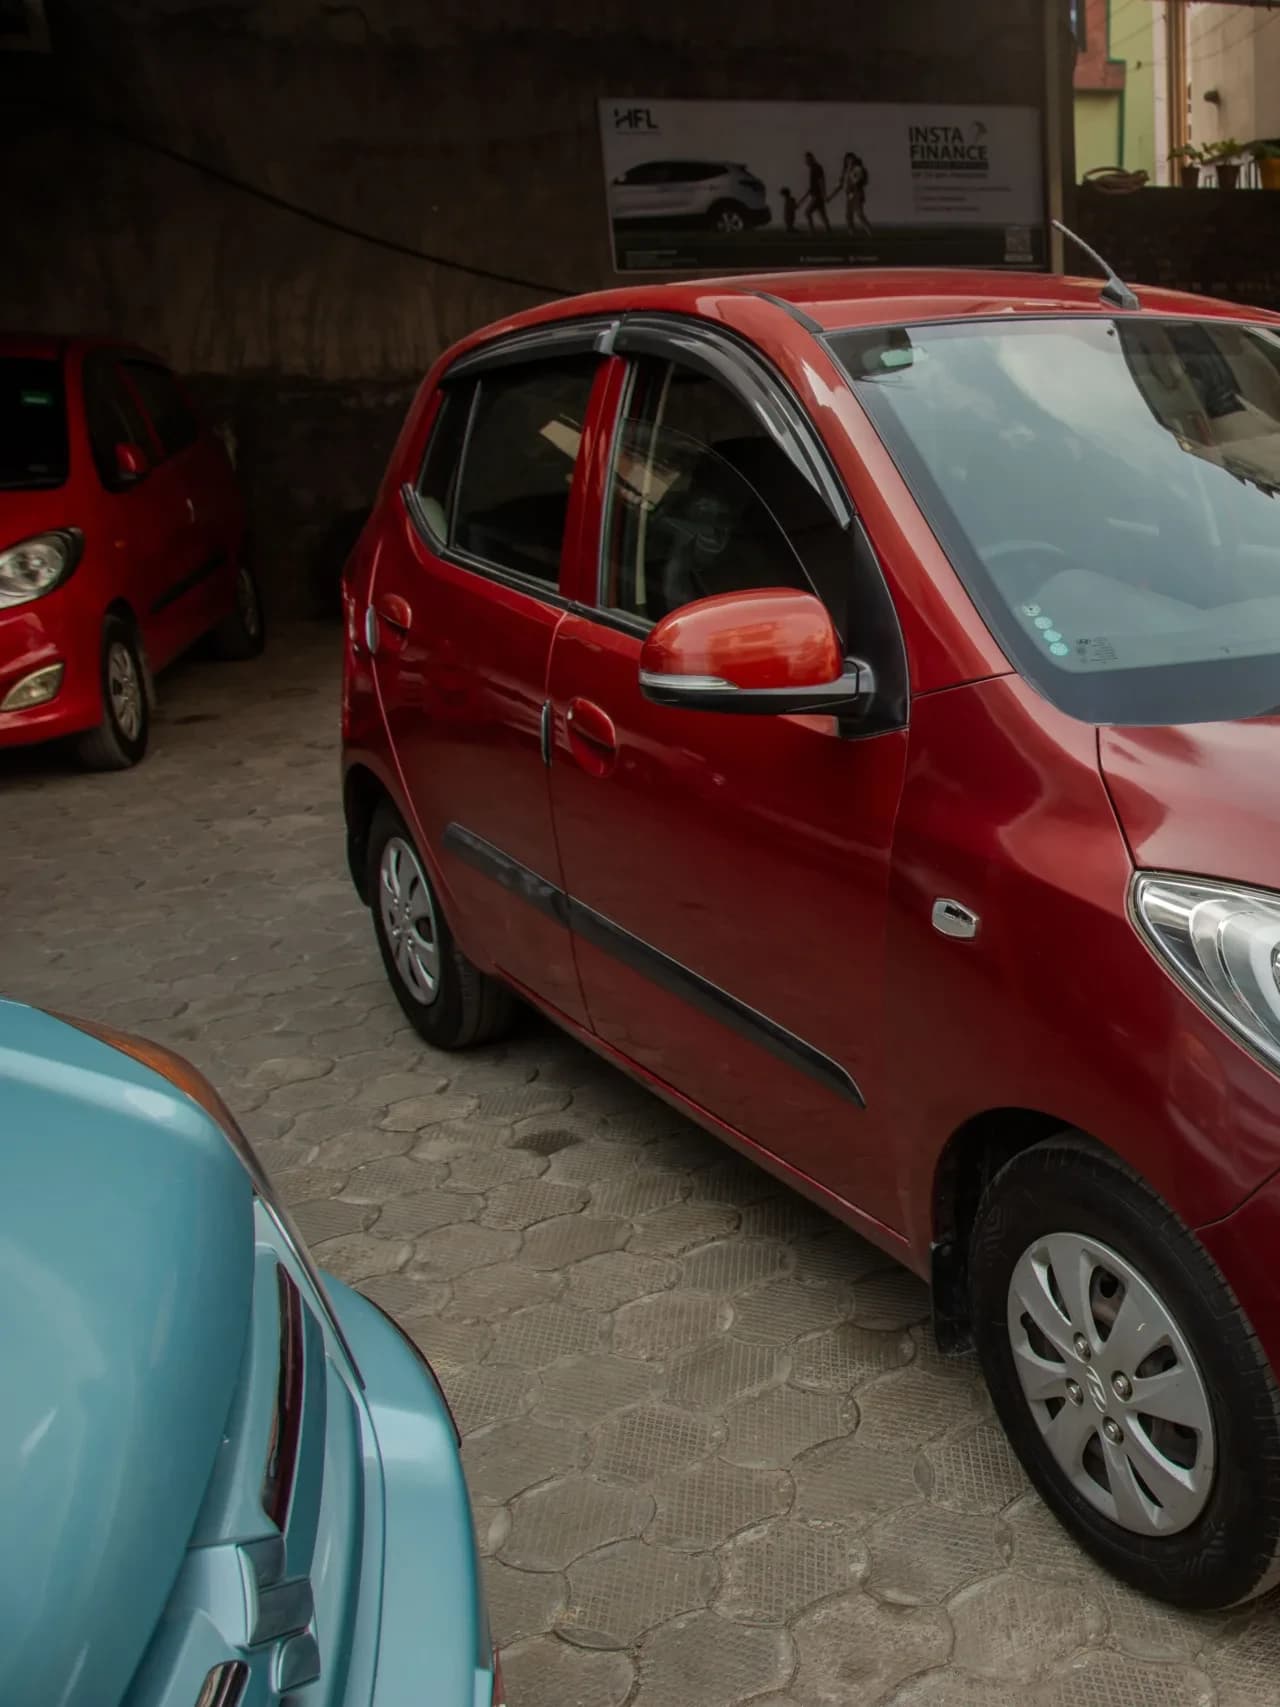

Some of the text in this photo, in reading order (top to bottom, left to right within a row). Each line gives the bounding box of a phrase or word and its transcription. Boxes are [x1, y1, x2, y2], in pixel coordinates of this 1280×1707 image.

[614, 108, 659, 128] HFL
[909, 126, 964, 143] INSTA
[910, 144, 988, 160] FINANCE
